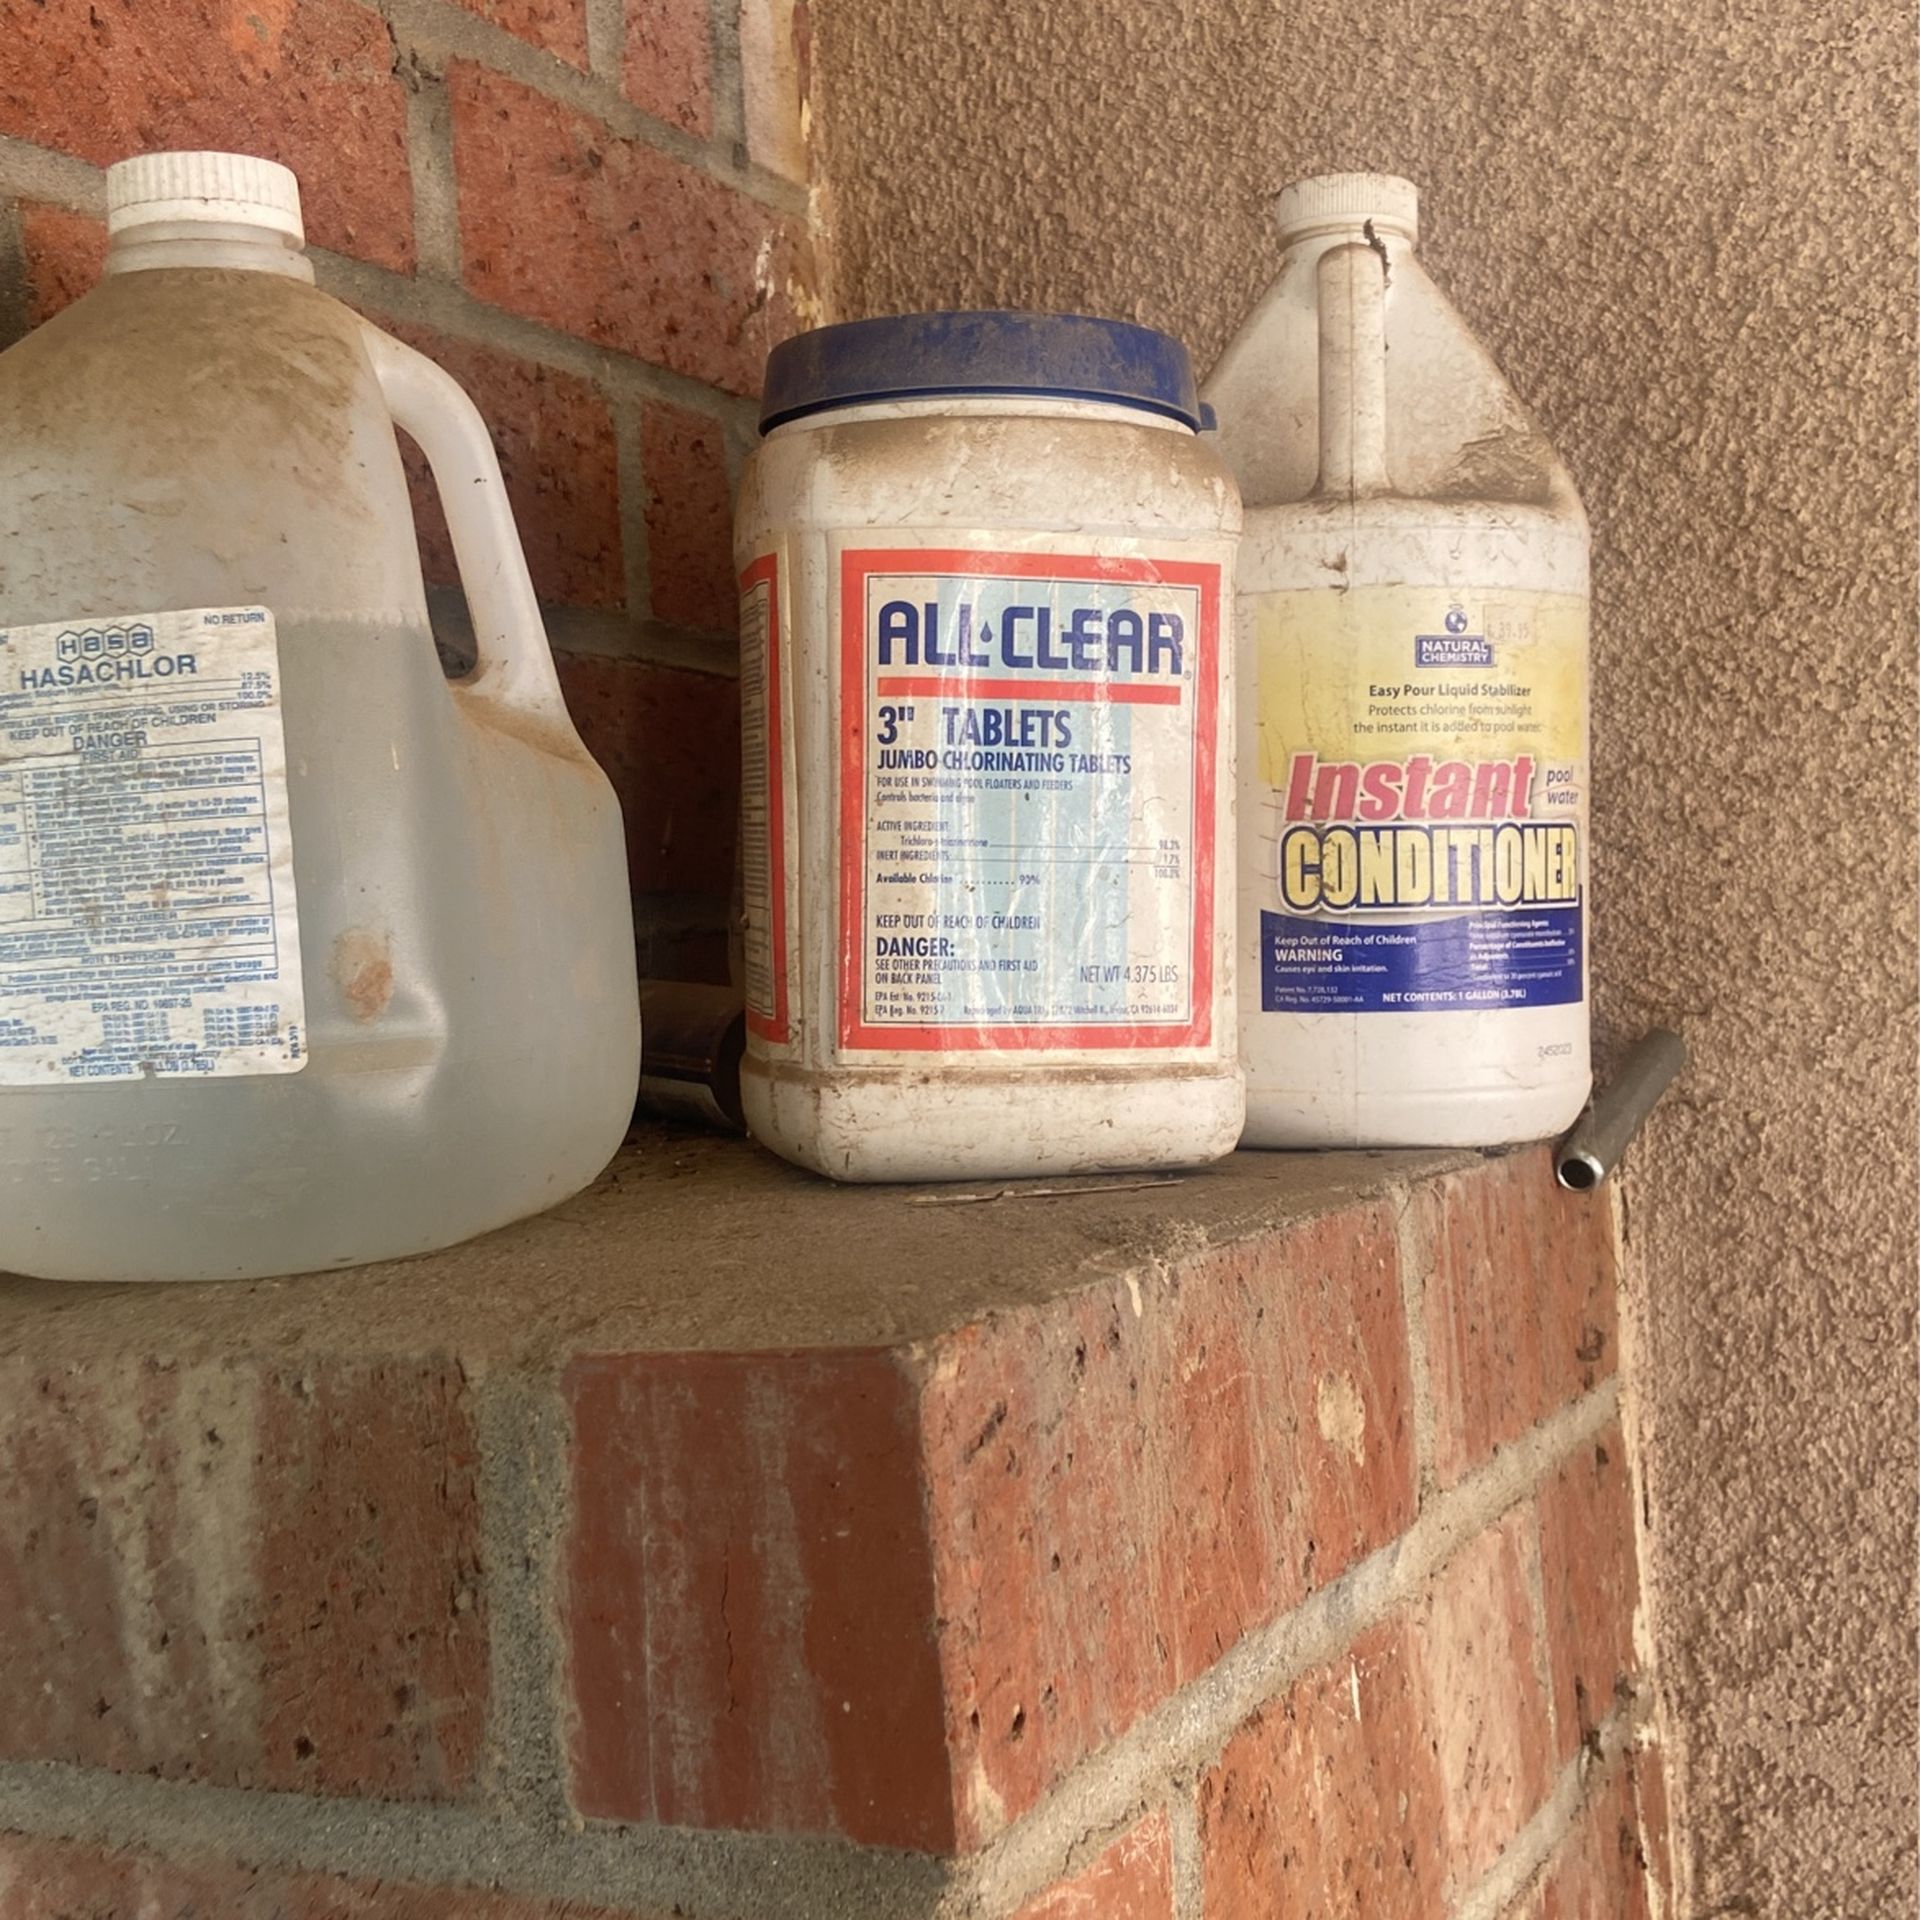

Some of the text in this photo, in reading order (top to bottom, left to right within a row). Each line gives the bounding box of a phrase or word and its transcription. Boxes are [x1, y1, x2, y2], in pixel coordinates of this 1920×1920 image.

[203, 612, 265, 625] NO RETURN
[878, 600, 1184, 675] ALL CLEAR
[1422, 640, 1489, 652] NATURAL
[1421, 652, 1489, 663] CHEMISTRY
[20, 654, 197, 690] HASACHLOR
[1369, 683, 1531, 700] Easy Pour Liquid Stabilizer
[200, 703, 216, 712] OR
[1368, 704, 1418, 716] Protects
[1419, 703, 1466, 716] chlorine
[1469, 703, 1494, 715] from
[42, 725, 65, 738] OUT
[68, 724, 84, 736] OF
[87, 720, 127, 733] REACH
[131, 717, 148, 730] OF
[151, 712, 217, 727] CHILDREN
[877, 705, 1072, 749] 3" TABLETS
[1353, 722, 1374, 734] the
[1377, 721, 1418, 733] instant
[1420, 720, 1430, 732] it
[1431, 720, 1441, 732] is
[1442, 719, 1479, 732] added
[1480, 720, 1492, 732] to
[1493, 721, 1515, 735] pool
[73, 731, 148, 751] DANGER
[877, 749, 1132, 775] JUMBO CHLORINATING TABLETS
[876, 776, 893, 789] FOR
[894, 776, 909, 788] USE
[911, 777, 920, 788] IN
[985, 778, 1021, 790] FLOATERS
[1023, 779, 1040, 790] AND
[1042, 780, 1073, 791] FEEDERS
[1546, 765, 1574, 787] pool
[1285, 754, 1535, 822] Instant
[876, 791, 907, 803] Controls
[1547, 790, 1579, 805] water
[876, 821, 902, 831] ACTIVE
[876, 850, 898, 861] INERT
[1283, 825, 1578, 907] CONDITIONER
[876, 873, 917, 884] Available
[876, 914, 901, 928] KEEP
[903, 915, 925, 928] OUT
[991, 915, 1041, 929] CHILDREN
[876, 936, 955, 957] DANGER:
[1274, 933, 1417, 947] Keep Out of Reach of Children
[1275, 948, 1343, 962] WARNING
[875, 958, 890, 971] SEE
[892, 958, 921, 971] OTHER
[998, 960, 1021, 972] FIRST
[1023, 960, 1038, 972] AID
[1275, 964, 1301, 973] Causes
[1302, 965, 1316, 975] eye
[1318, 964, 1333, 973] and
[1334, 963, 1350, 973] skin
[875, 973, 942, 985] ON BACK PANEL
[1080, 965, 1179, 983] NET WT 4.375 LBS
[1382, 992, 1402, 1003] NET
[1403, 991, 1456, 1002] CONTENTS:
[1458, 990, 1463, 1000] 1
[1465, 989, 1500, 1000] GALLON
